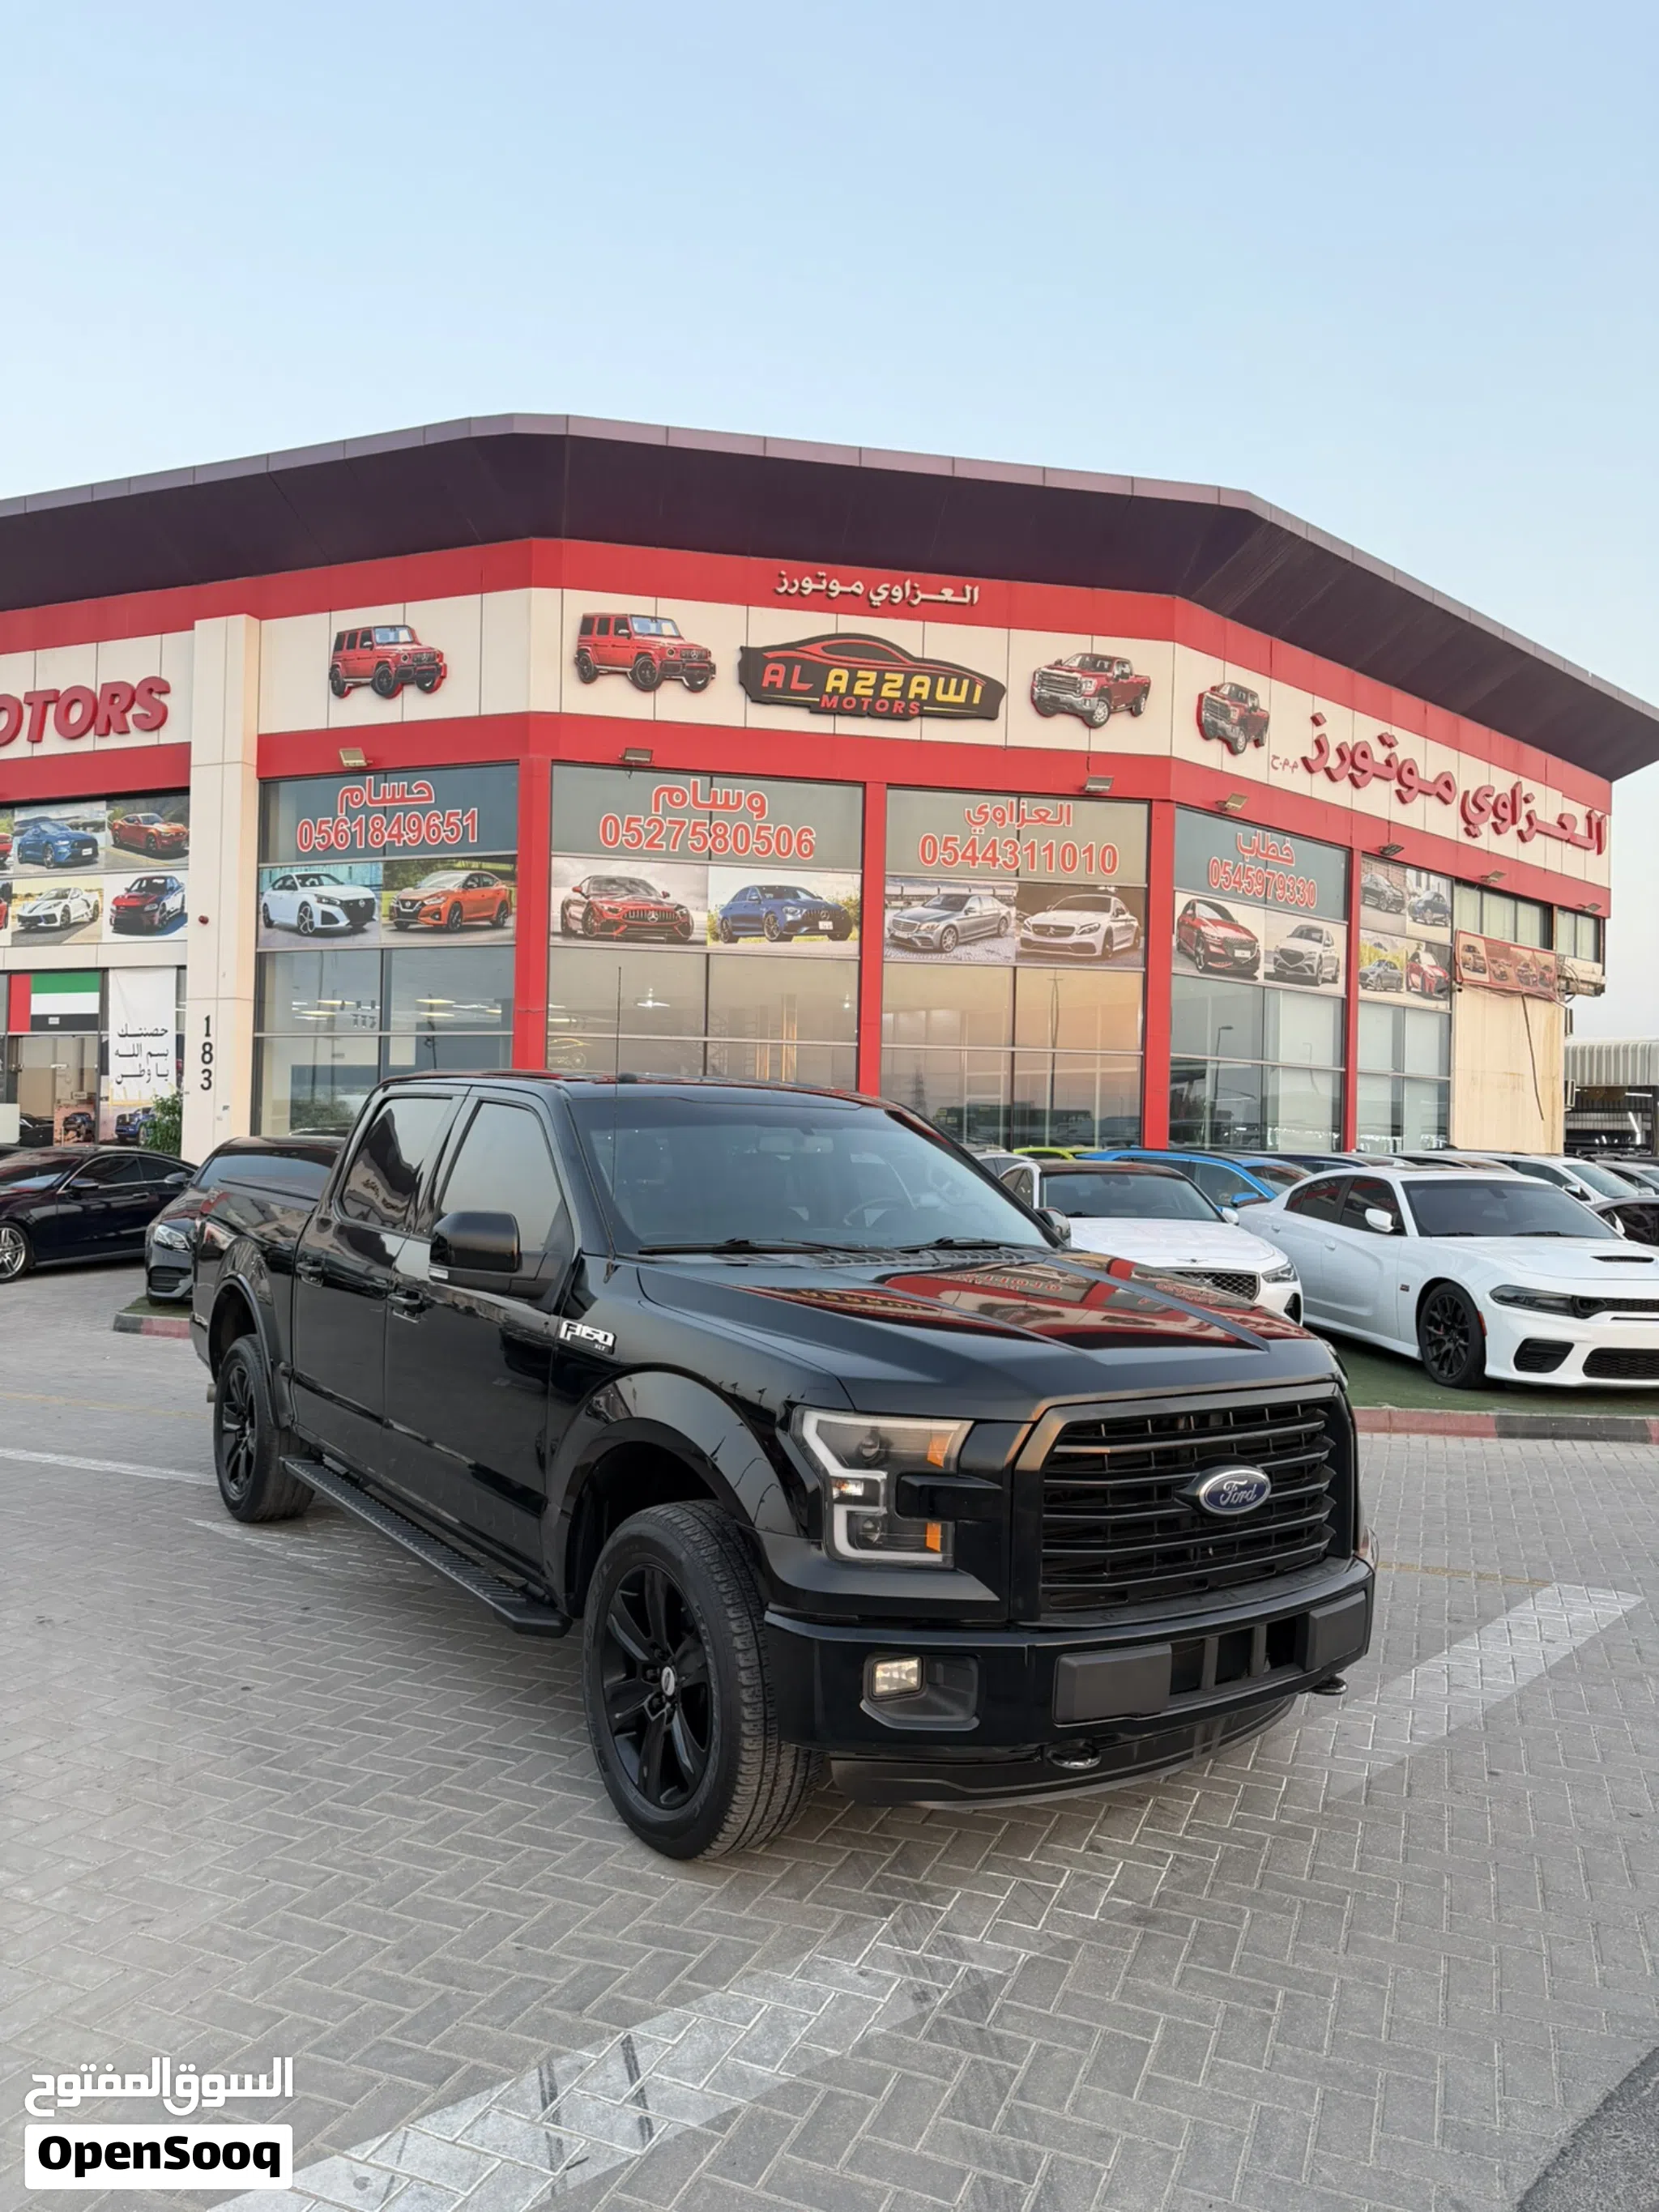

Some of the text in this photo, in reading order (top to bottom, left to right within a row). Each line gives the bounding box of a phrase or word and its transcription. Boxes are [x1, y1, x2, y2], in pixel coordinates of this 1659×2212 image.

[775, 570, 980, 607] العزاوي موتورز
[761, 663, 983, 705] AL AZZAWI
[819, 694, 921, 715] MOTORS
[338, 776, 435, 816] حسام
[652, 778, 768, 821] وسام
[1301, 712, 1609, 855] العزاوي موتورز
[297, 808, 478, 852] 0561849651
[599, 812, 816, 859] 0527580506
[965, 799, 1073, 834] العزاوي
[919, 833, 1119, 876] 0544311010
[1237, 830, 1295, 867] خطاب
[1209, 856, 1317, 909] 0545979330
[114, 1042, 169, 1065] بسم الله
[156, 1063, 169, 1080] يا
[199, 1014, 214, 1090] 183
[1219, 1480, 1258, 1506] Ford
